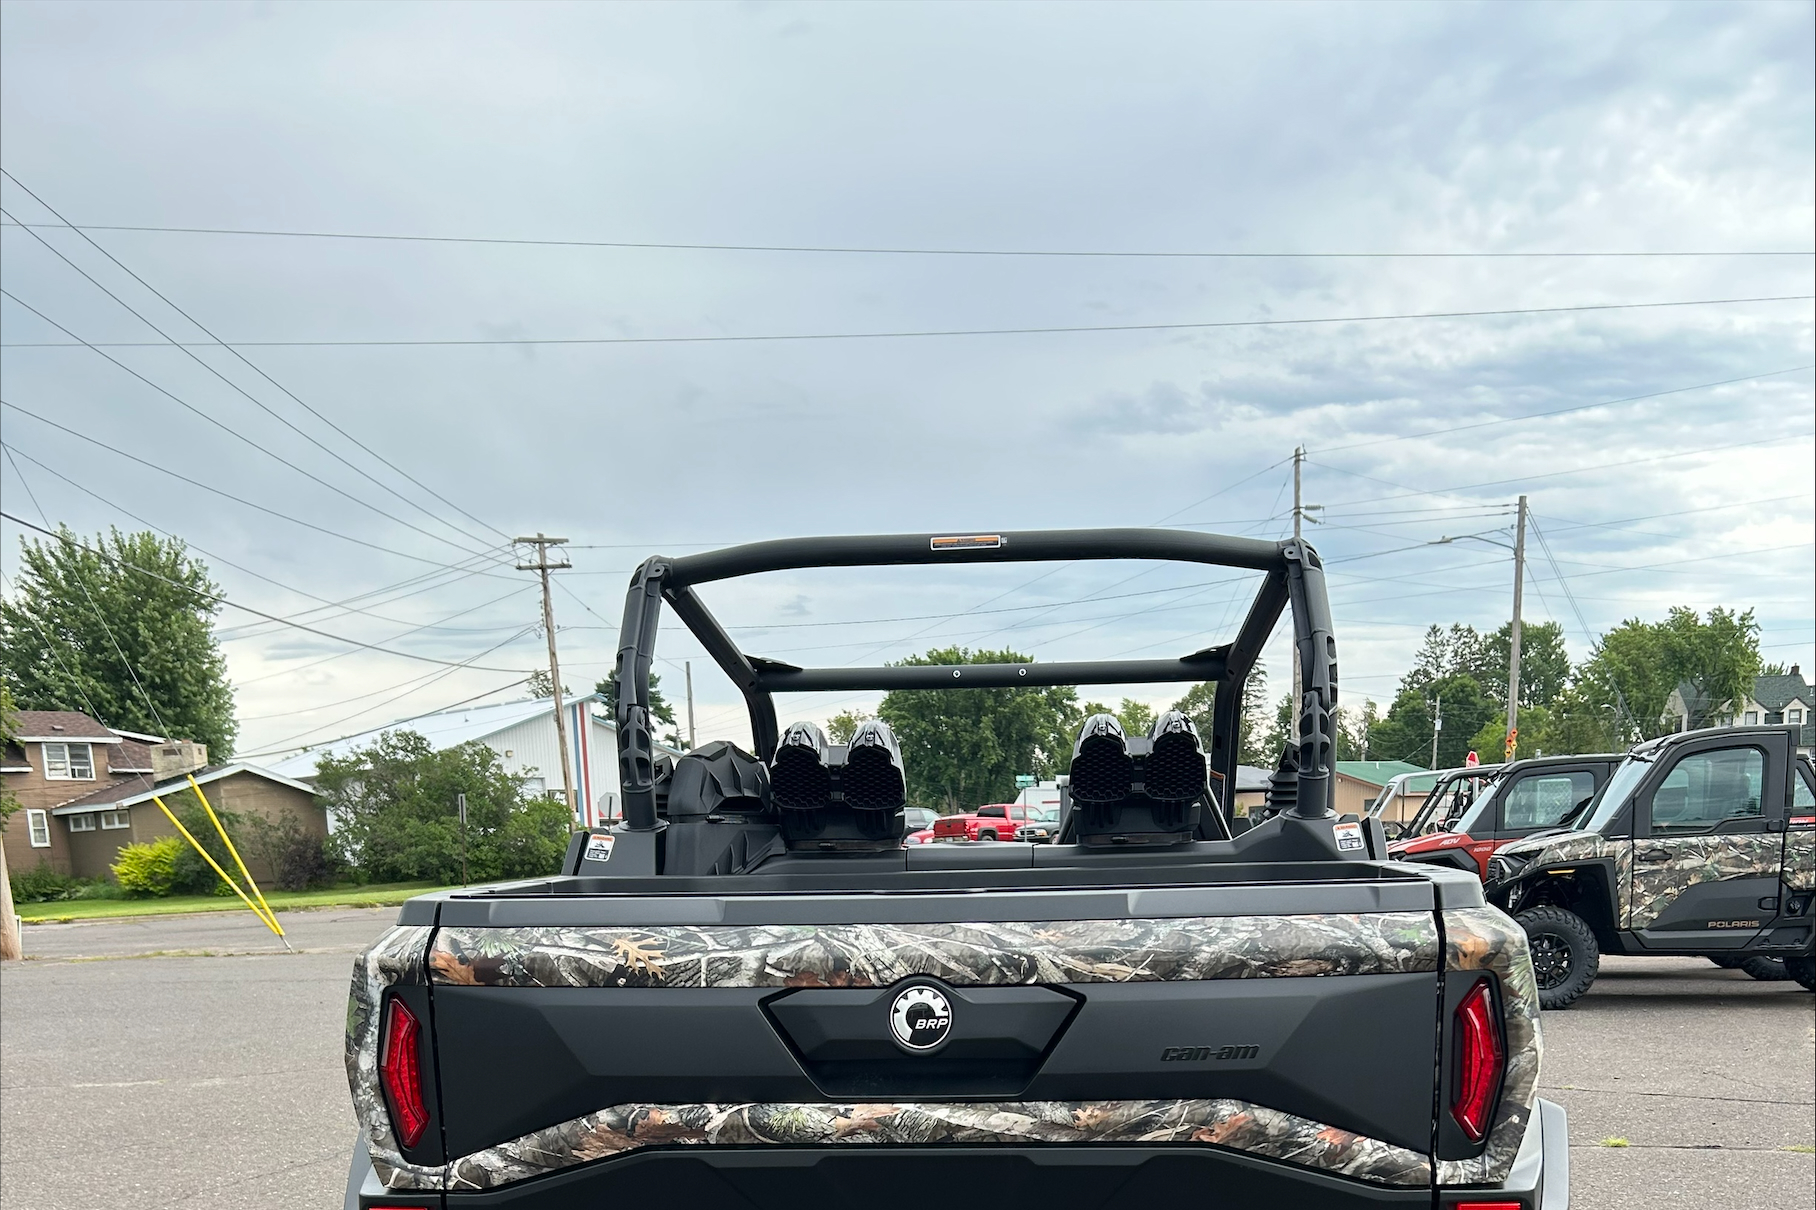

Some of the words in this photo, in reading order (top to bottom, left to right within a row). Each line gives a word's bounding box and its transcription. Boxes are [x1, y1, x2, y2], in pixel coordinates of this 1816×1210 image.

[1439, 837, 1461, 847] ADV
[1707, 920, 1759, 928] POLARIS
[915, 1018, 949, 1030] BRP
[1160, 1044, 1260, 1061] can-am
